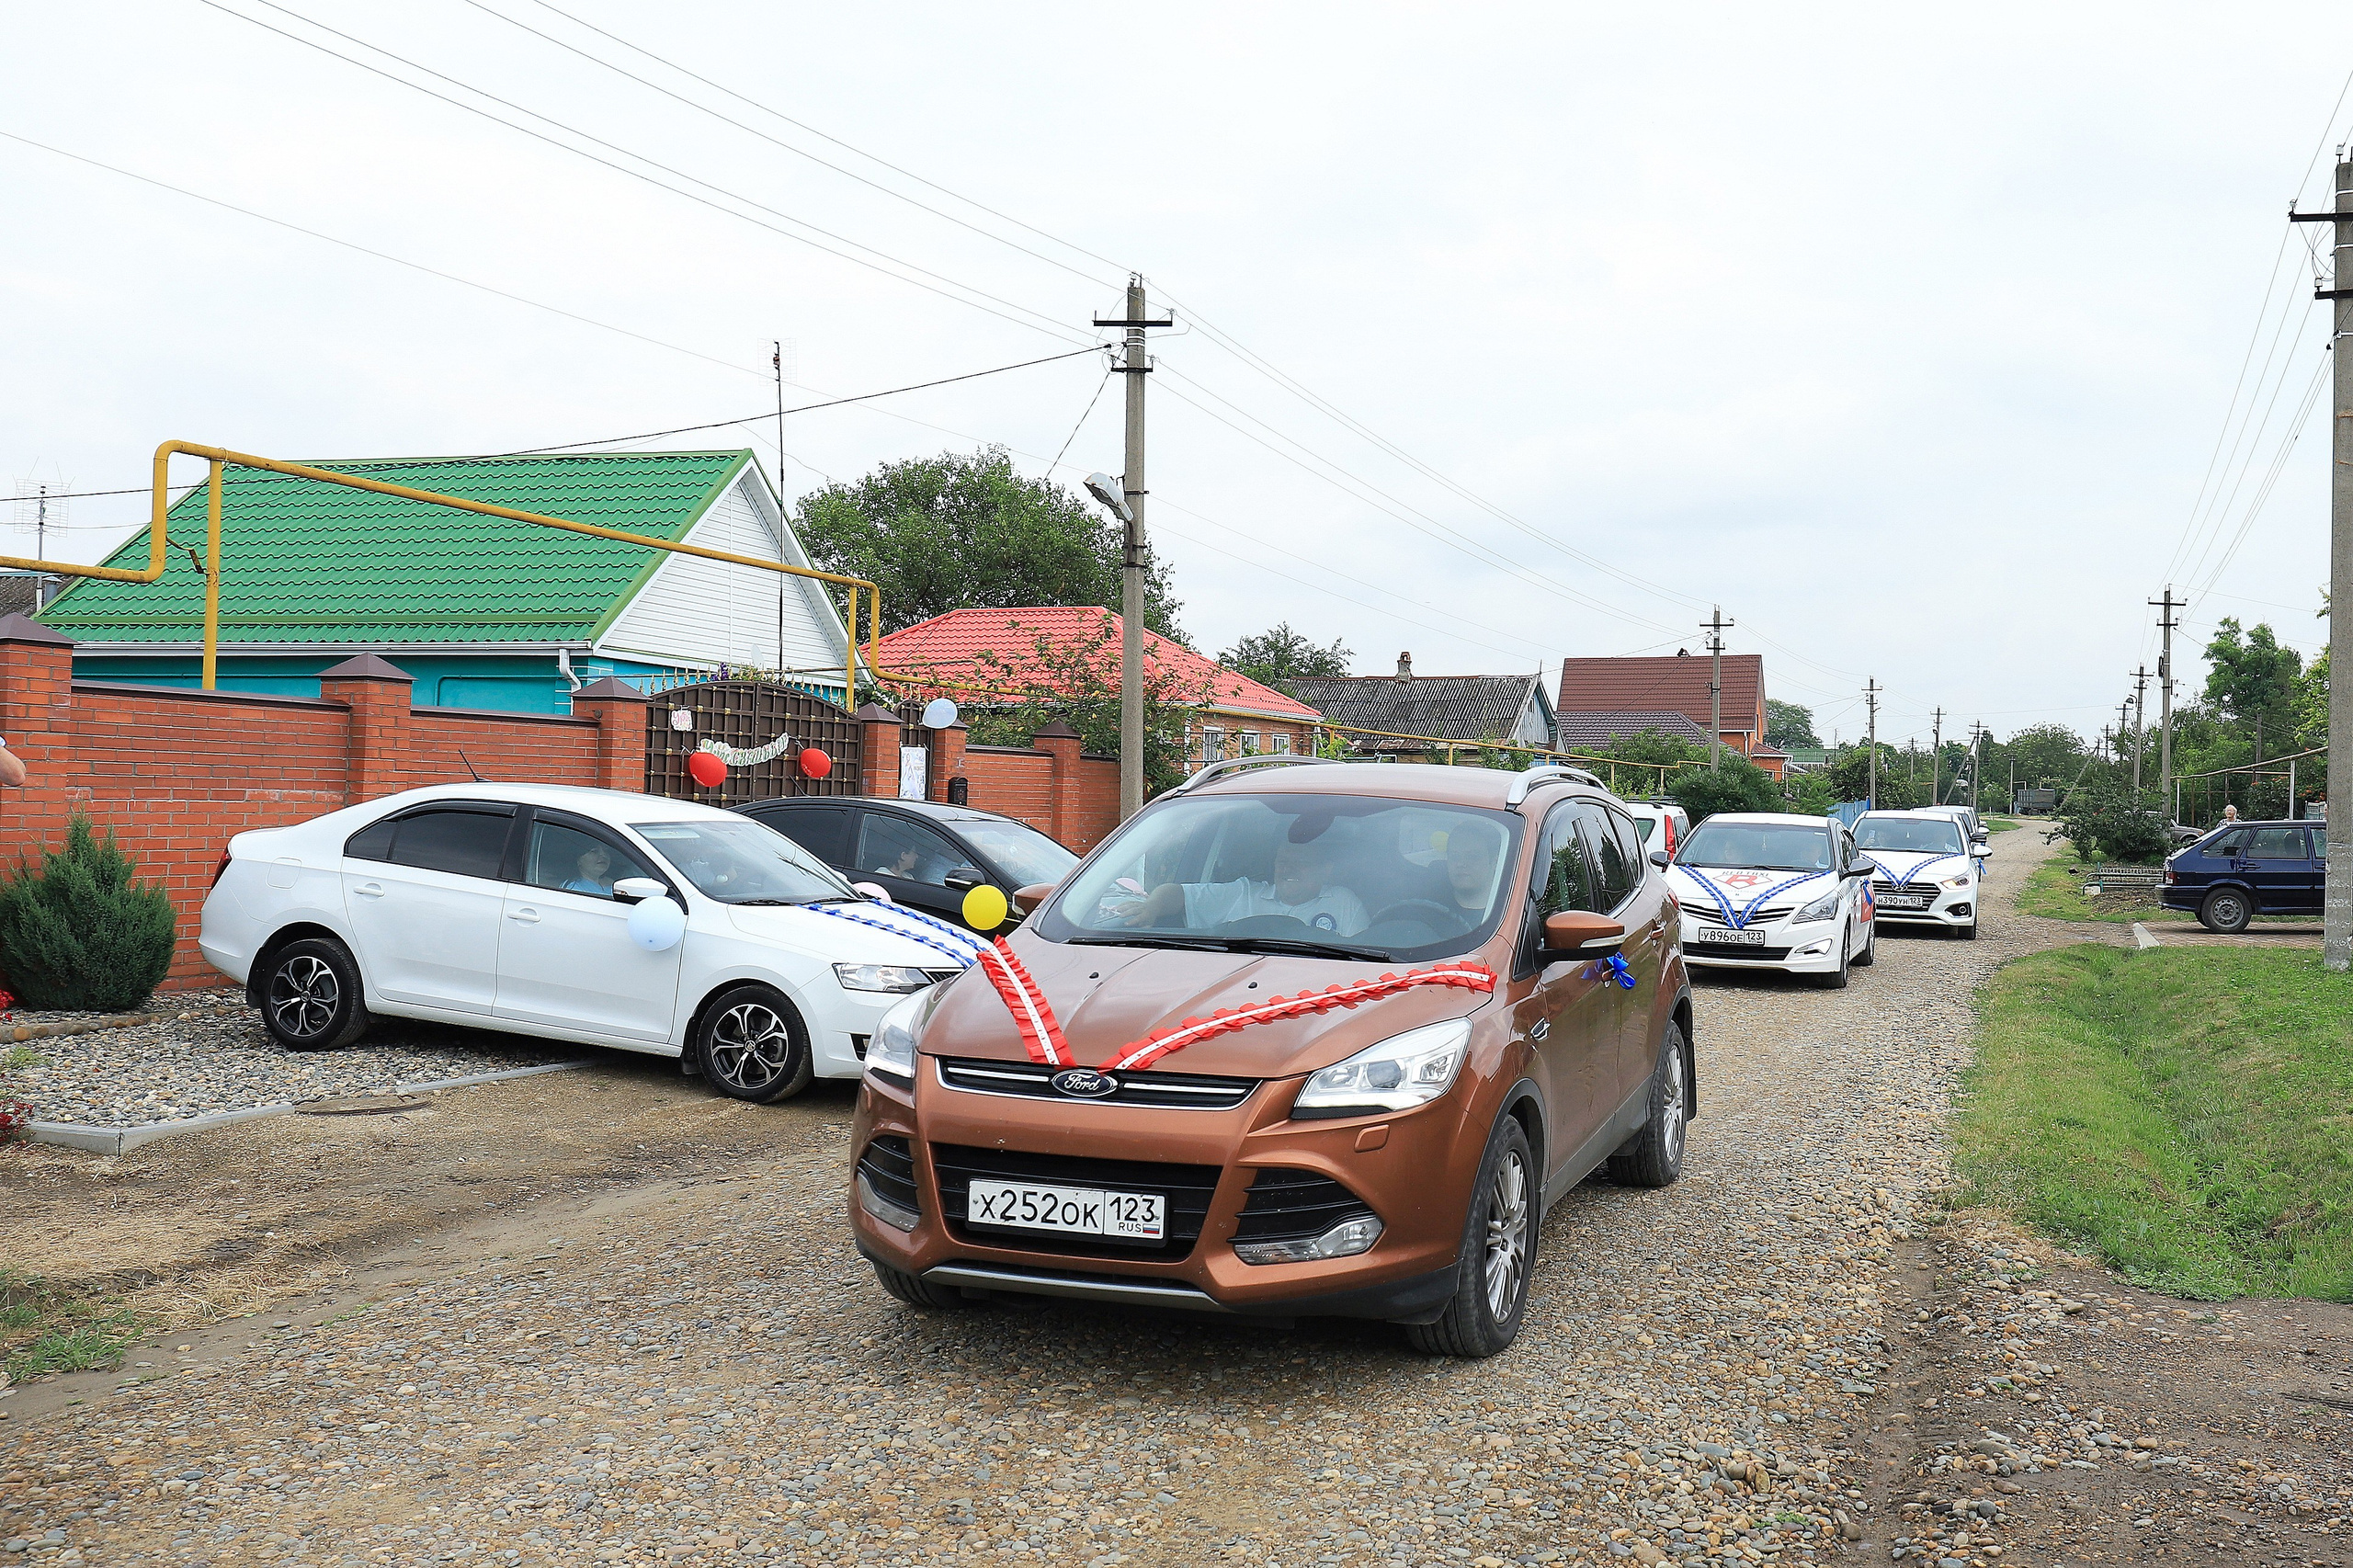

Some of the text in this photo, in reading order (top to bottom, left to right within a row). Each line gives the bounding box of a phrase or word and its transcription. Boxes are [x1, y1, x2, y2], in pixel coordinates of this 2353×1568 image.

[1703, 930, 1761, 943] У896ОЕ 123
[1063, 1073, 1101, 1091] Ford
[979, 1188, 1155, 1229] Х252ОК 123
[1118, 1221, 1142, 1233] RUS
